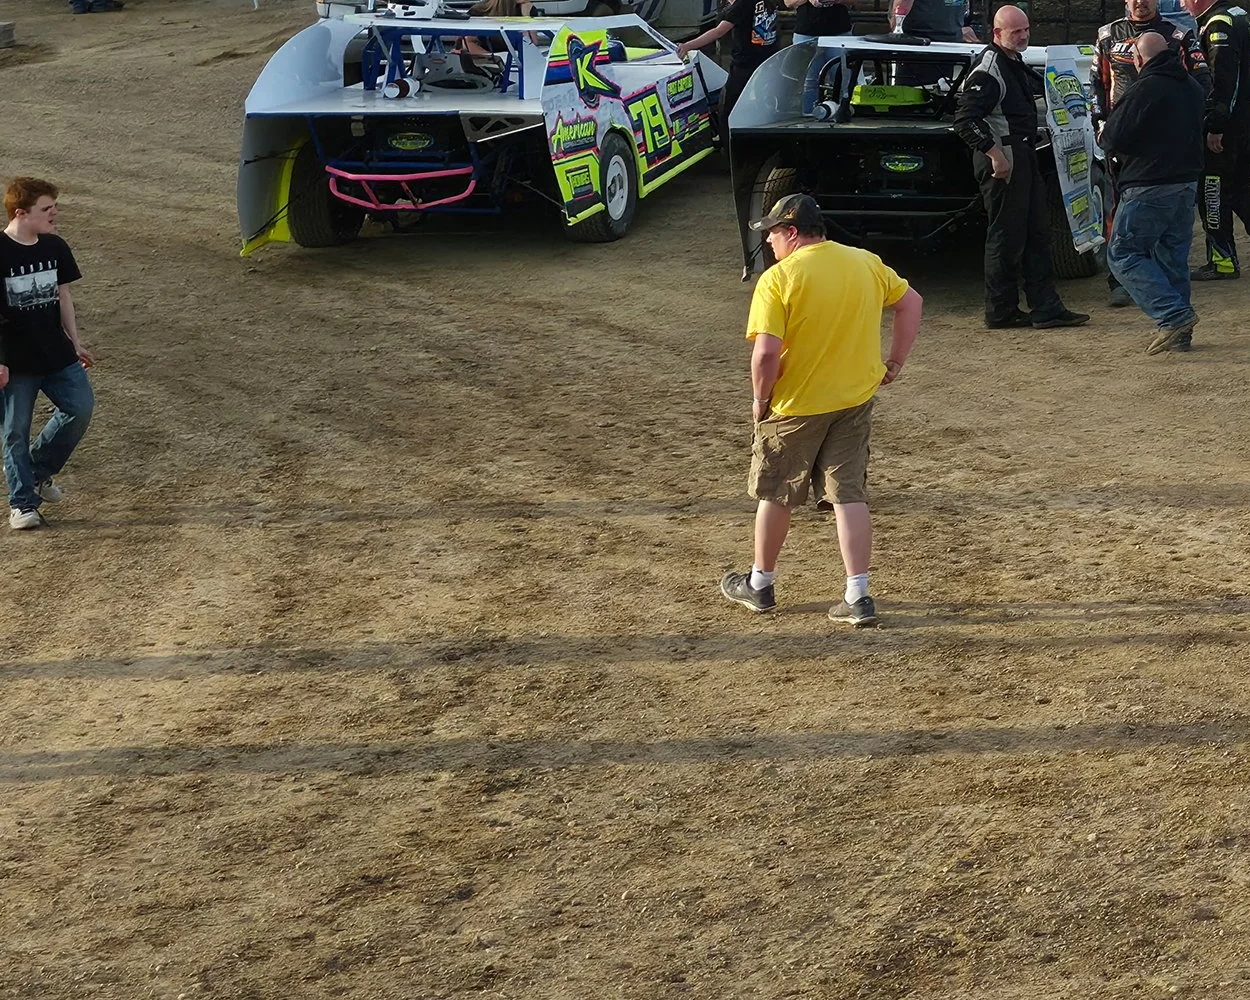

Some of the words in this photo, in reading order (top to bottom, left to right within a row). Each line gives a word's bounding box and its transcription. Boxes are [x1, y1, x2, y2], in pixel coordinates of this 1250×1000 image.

[576, 52, 613, 91] K
[551, 118, 596, 153] American
[628, 93, 671, 154] 79
